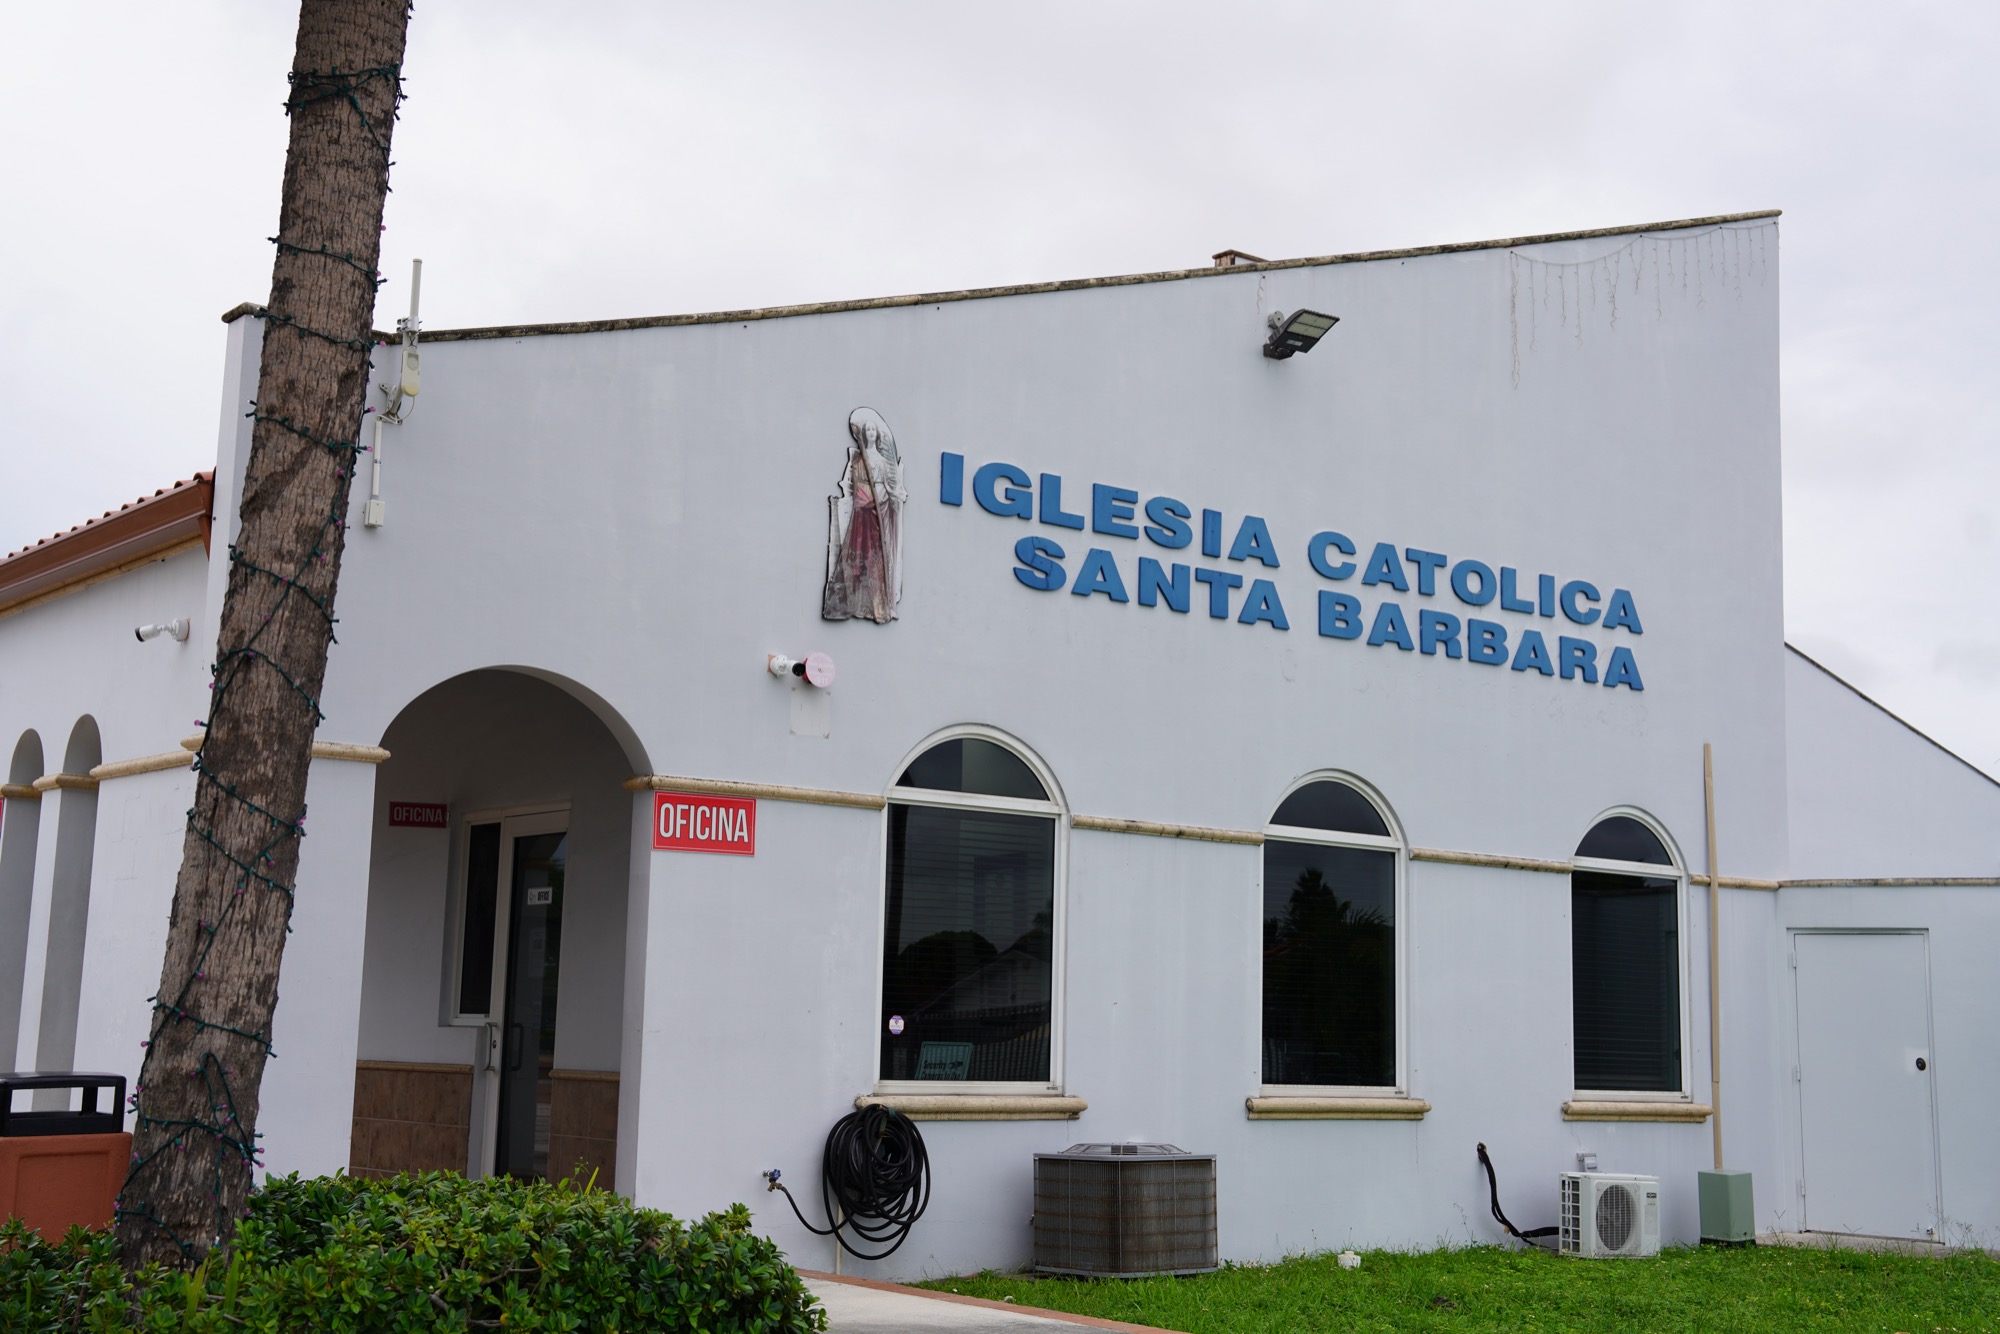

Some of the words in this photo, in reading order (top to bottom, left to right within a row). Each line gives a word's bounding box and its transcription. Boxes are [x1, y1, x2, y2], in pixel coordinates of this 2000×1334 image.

[940, 452, 1281, 568] IGLESIA
[1308, 531, 1644, 635] CATOLICA
[1013, 535, 1290, 630] SANTA
[1317, 590, 1645, 691] BARBARA
[394, 806, 443, 823] OFICINA
[659, 801, 749, 843] OFICINA
[537, 891, 550, 901] OFFICE
[923, 1060, 946, 1071] Security
